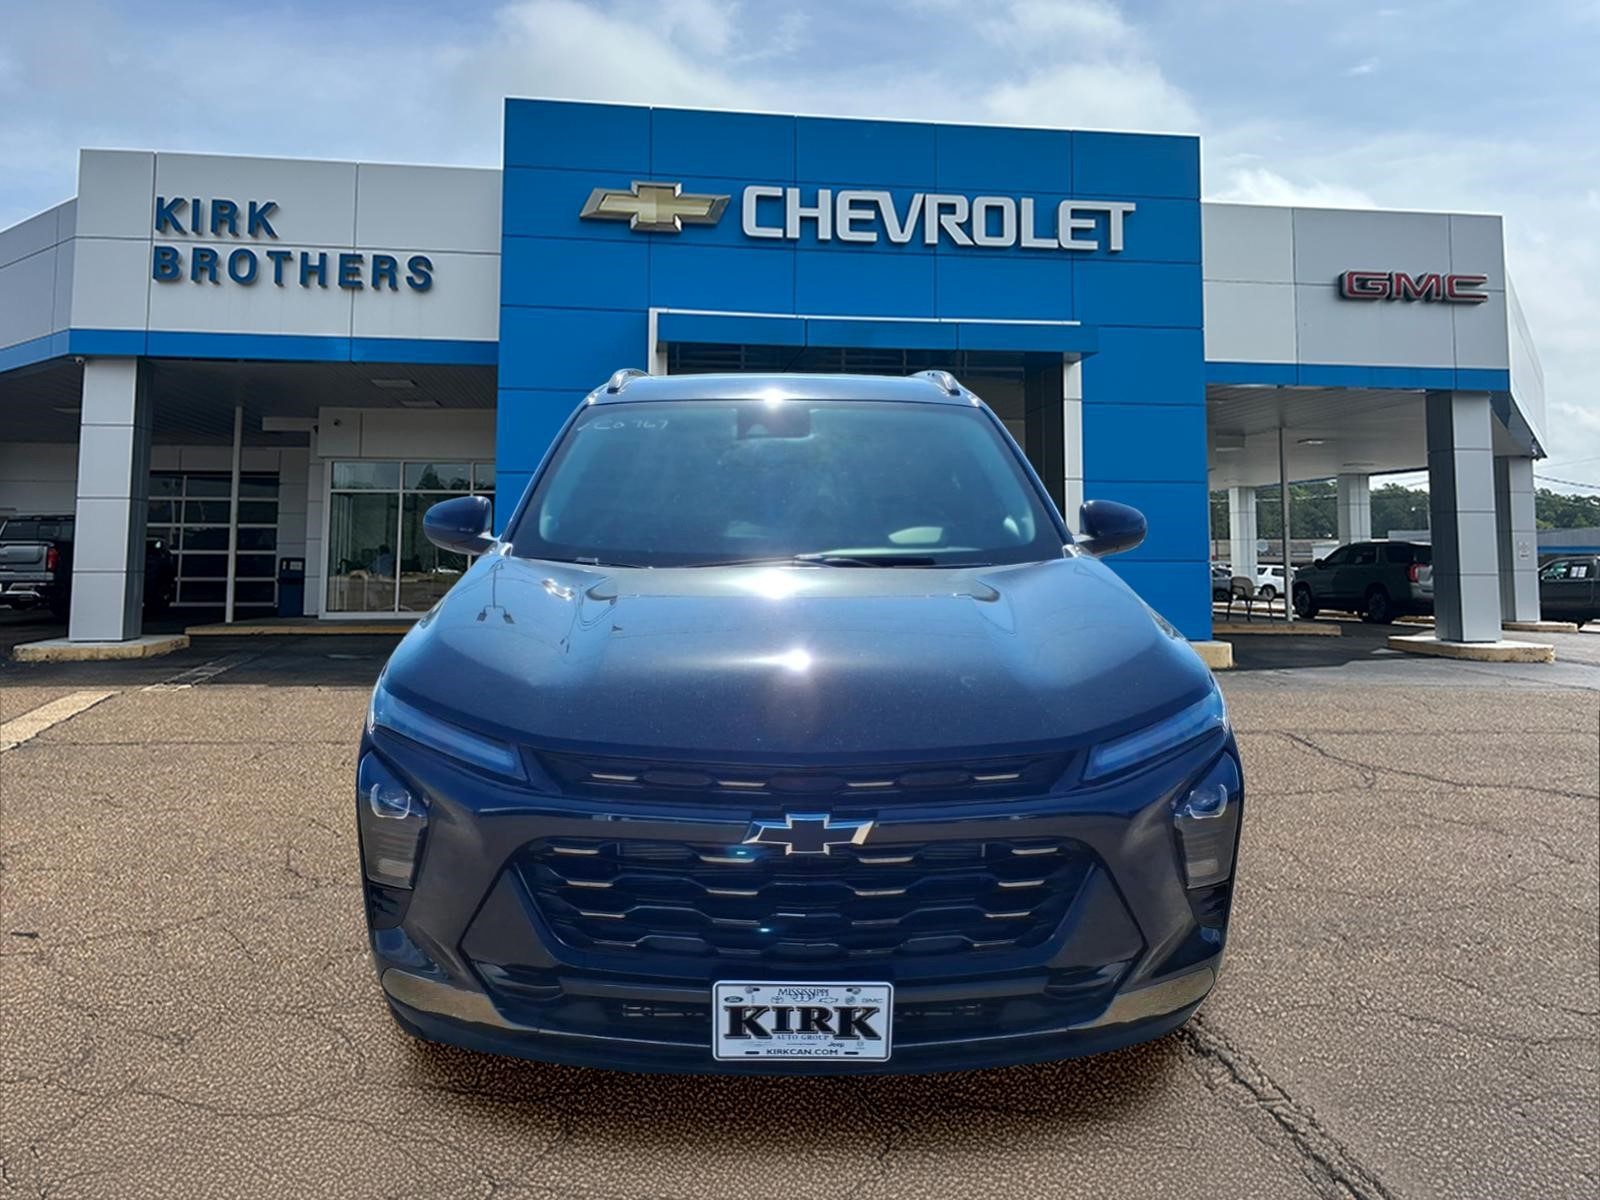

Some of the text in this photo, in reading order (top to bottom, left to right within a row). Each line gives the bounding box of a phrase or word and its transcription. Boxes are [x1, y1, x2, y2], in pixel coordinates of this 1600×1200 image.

[155, 196, 279, 239] KIRK
[742, 184, 1137, 252] CHEVROLET
[153, 245, 434, 292] BROTHERS
[1339, 271, 1488, 303] GMC
[723, 1006, 881, 1040] KIRK
[766, 1048, 838, 1056] KIRKCAN.COM
